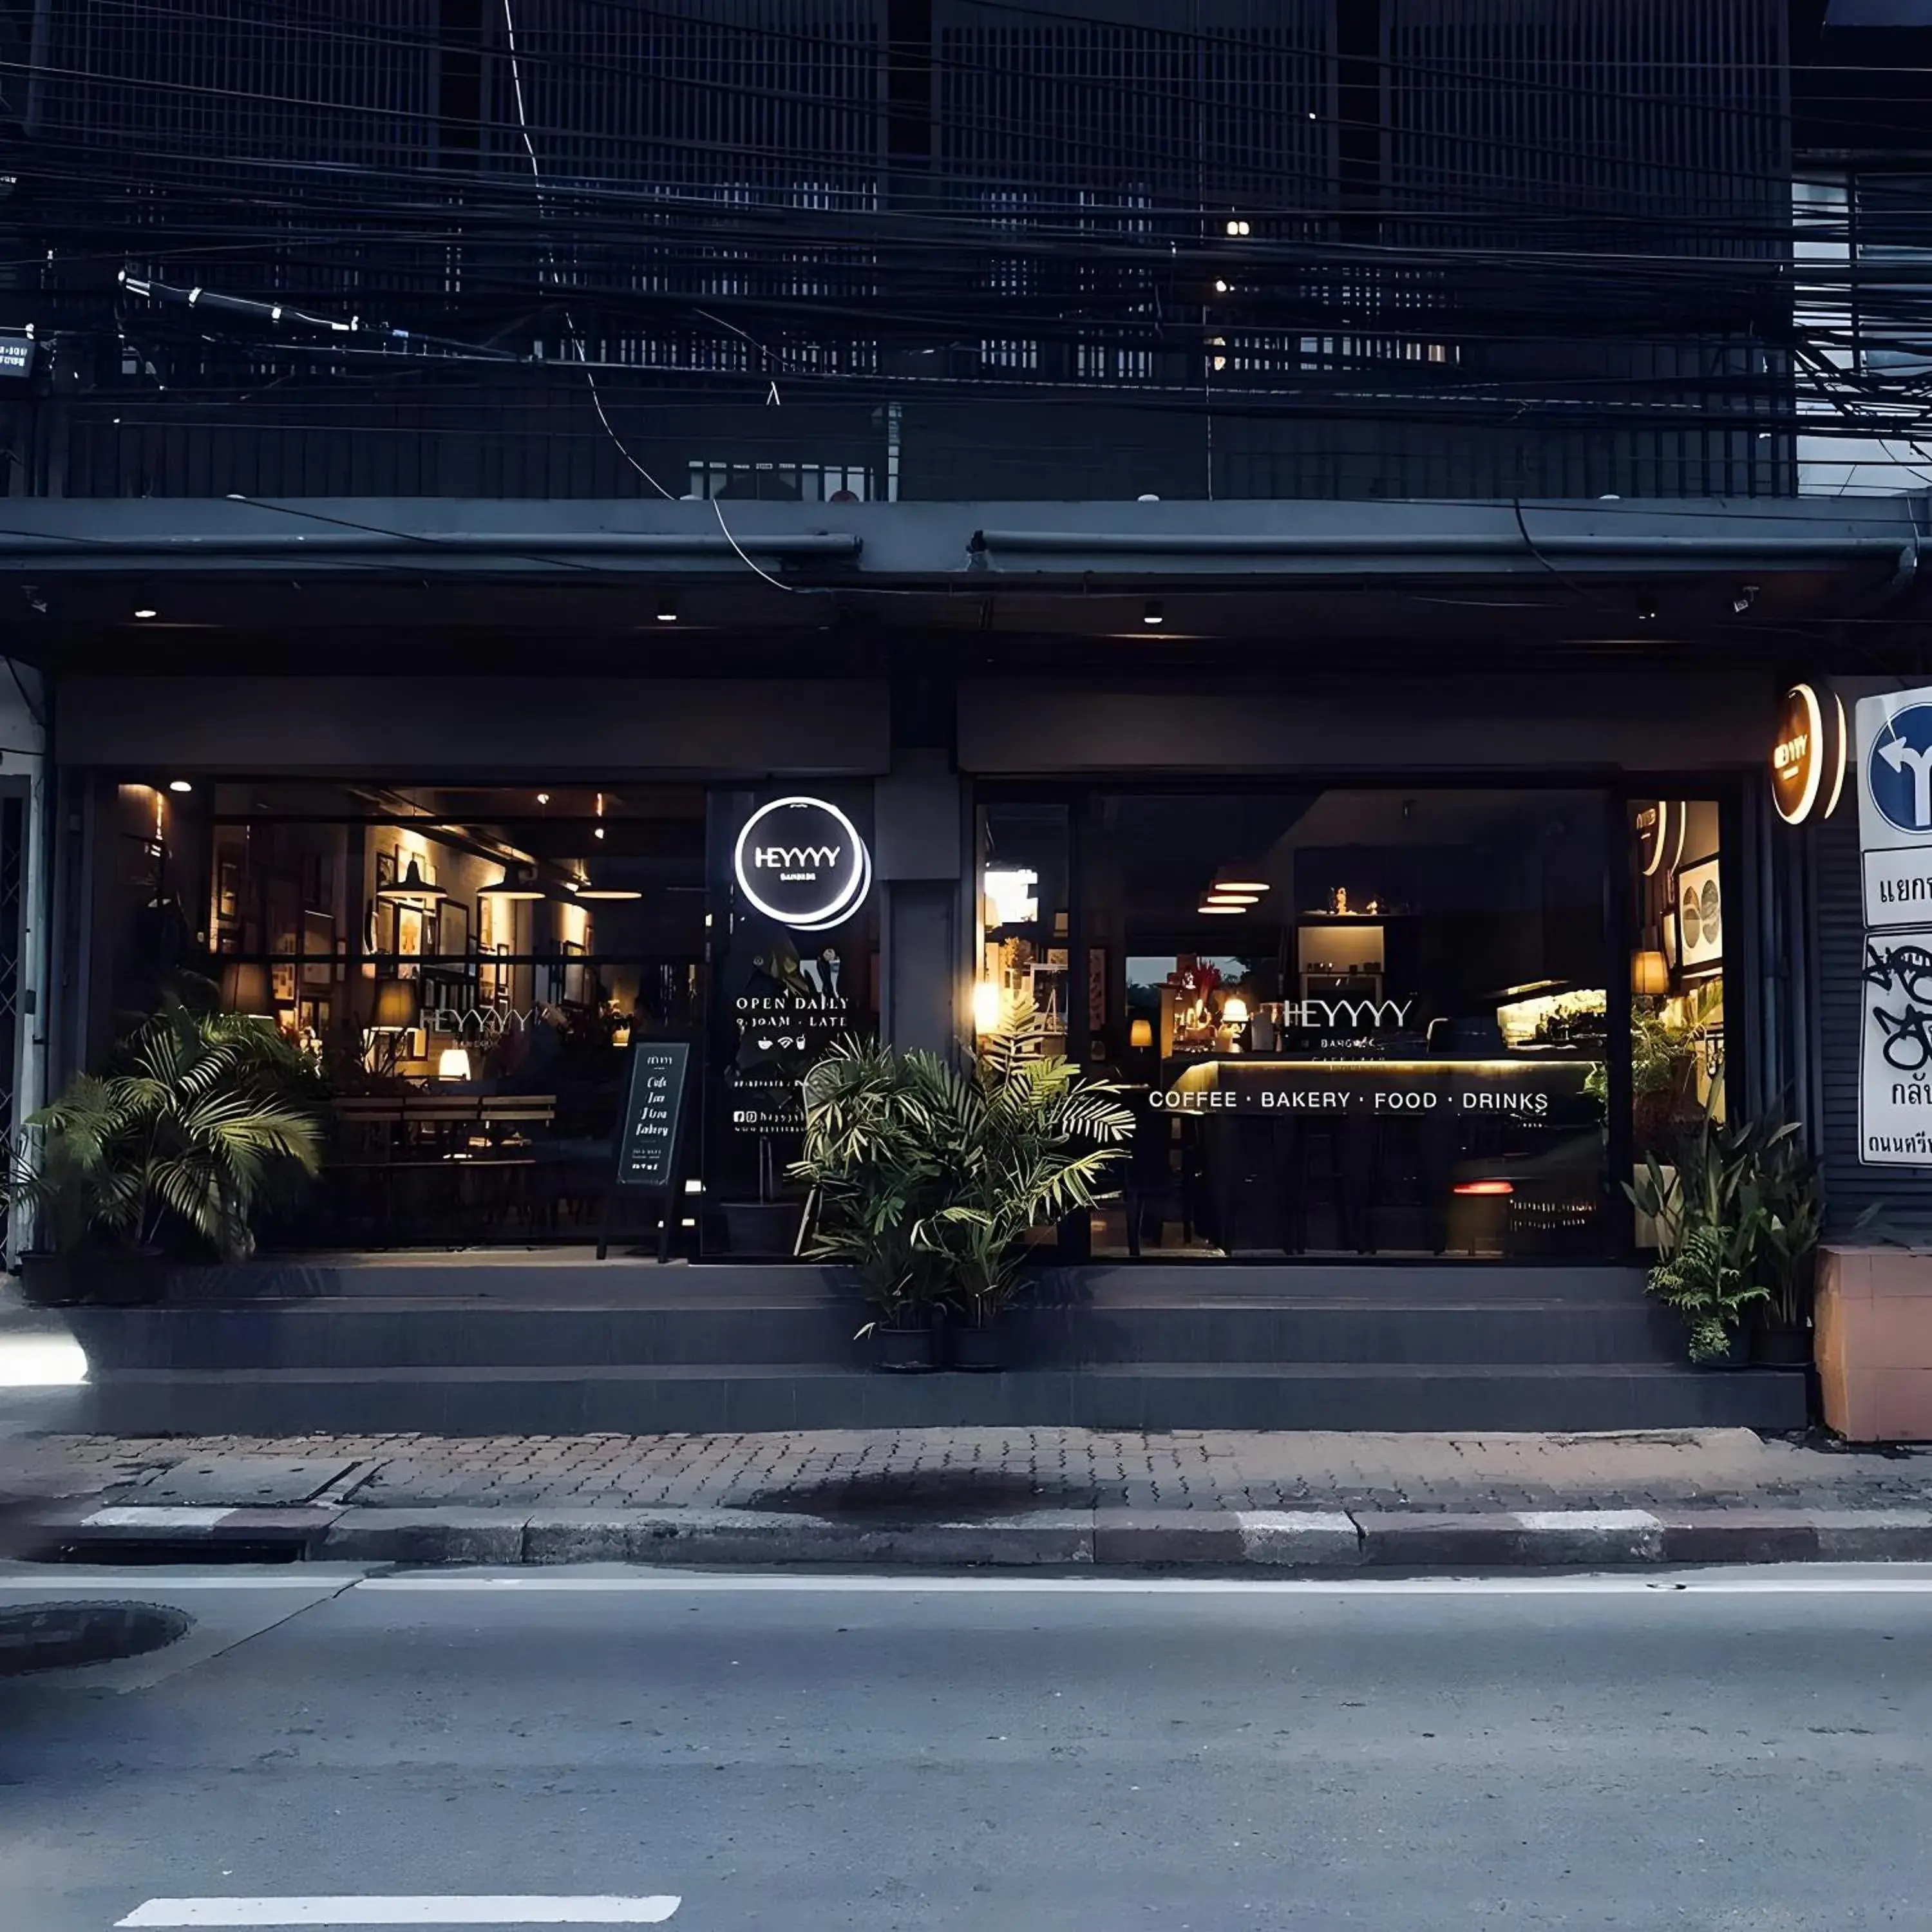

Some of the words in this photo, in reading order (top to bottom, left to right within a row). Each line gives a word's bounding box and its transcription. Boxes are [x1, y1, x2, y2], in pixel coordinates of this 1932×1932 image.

[755, 846, 840, 867] HEYYYY
[736, 998, 785, 1009] OPEN
[795, 998, 848, 1010] DAILY
[1284, 999, 1412, 1027] HEYYYY
[809, 1016, 847, 1027] LATE
[1148, 1091, 1236, 1108] COFFEE
[1260, 1091, 1350, 1108] BAKERY
[1374, 1093, 1437, 1109] FOOD
[1463, 1093, 1548, 1110] DRINKS
